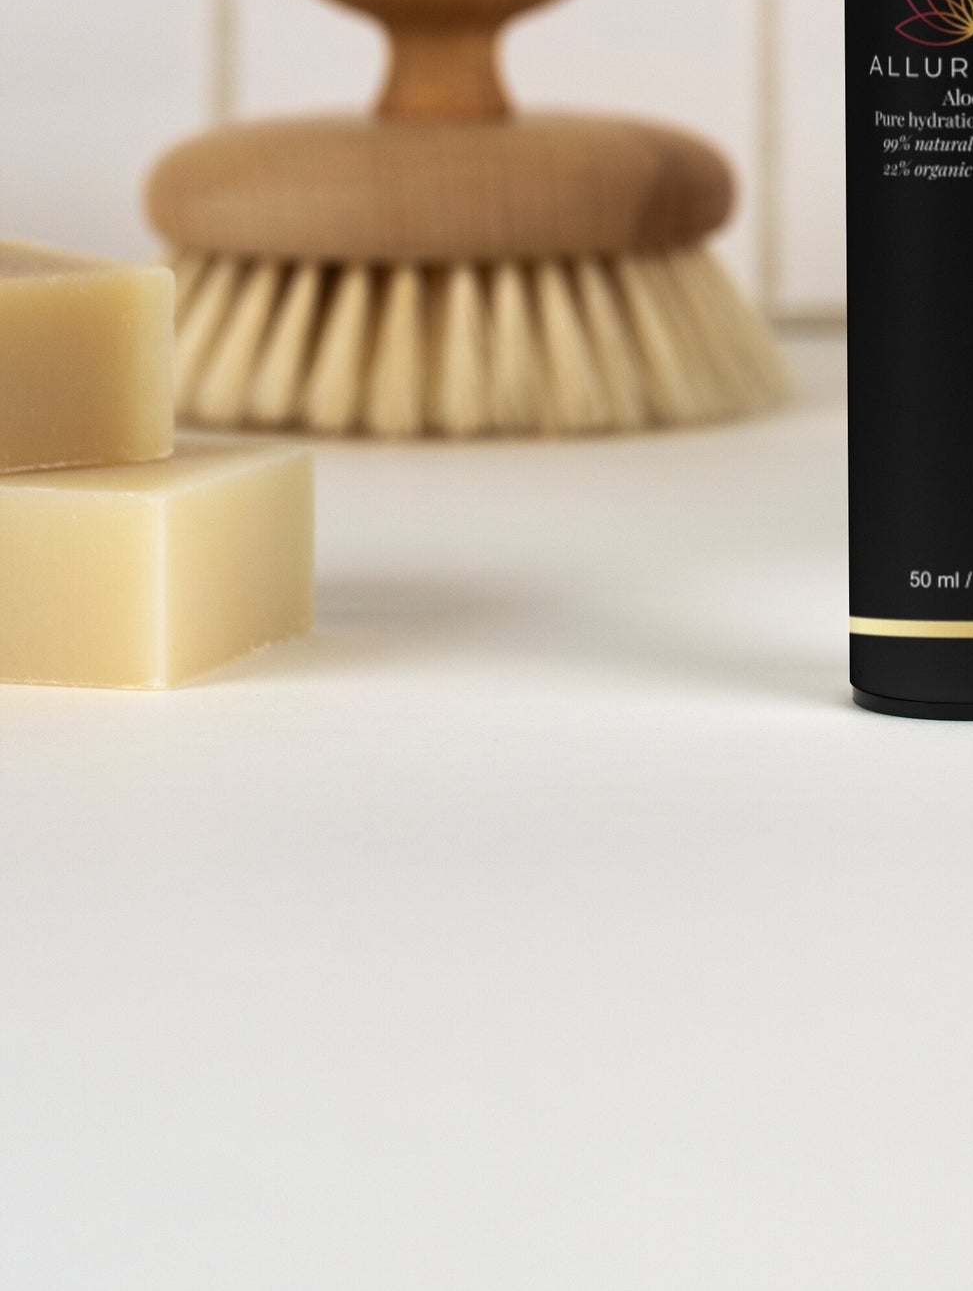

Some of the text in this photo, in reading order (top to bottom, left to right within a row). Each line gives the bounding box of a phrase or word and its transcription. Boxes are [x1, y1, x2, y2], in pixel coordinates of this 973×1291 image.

[875, 110, 905, 128] Pure
[883, 135, 911, 153] 99%
[915, 136, 973, 152] natural
[883, 160, 911, 177] 22%
[914, 162, 973, 181] organic
[909, 570, 932, 589] 50
[937, 571, 960, 589] ml
[964, 571, 973, 589] /
